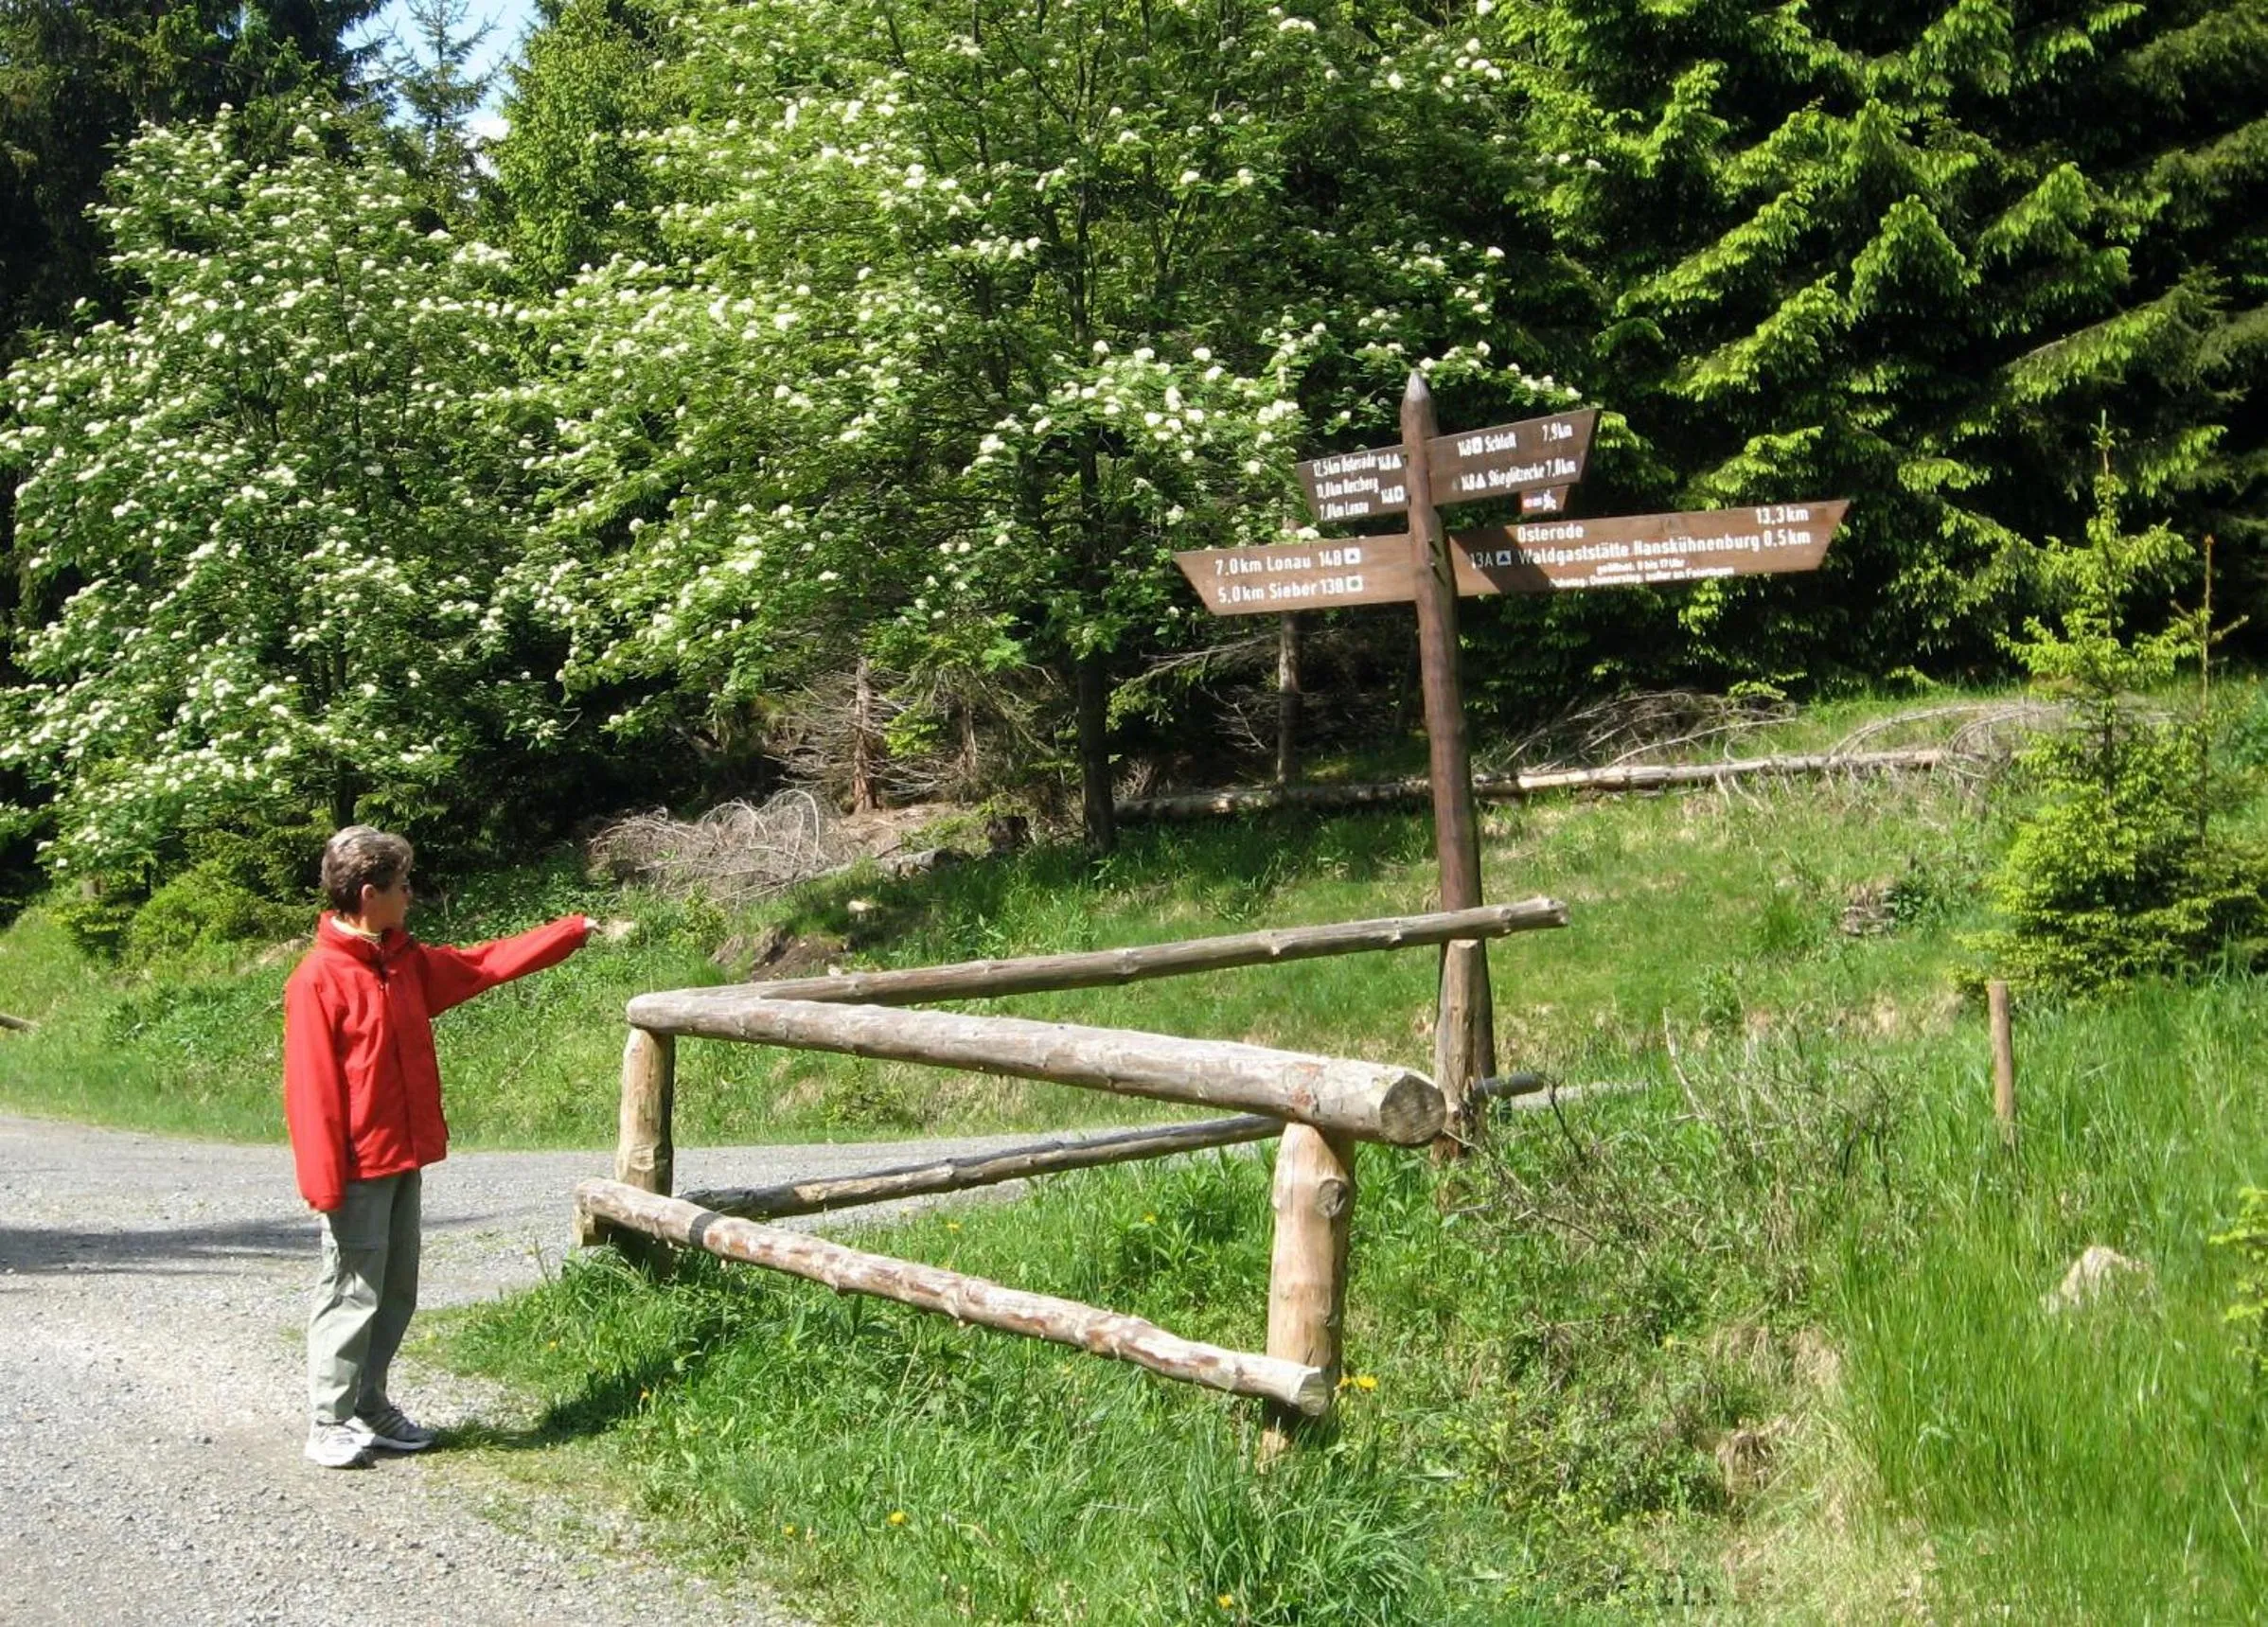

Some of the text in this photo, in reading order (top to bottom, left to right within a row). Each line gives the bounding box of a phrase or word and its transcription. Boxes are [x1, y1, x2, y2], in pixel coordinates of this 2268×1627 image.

[1345, 500, 1369, 517] Lonau
[1517, 523, 1584, 542] Osterode
[1470, 551, 1494, 570] 13A
[1518, 542, 1628, 567] Waldgaststätte
[1633, 534, 1760, 556] Hanskühnenburg
[1267, 555, 1312, 573] Lonau
[1268, 581, 1318, 600] Sieber
